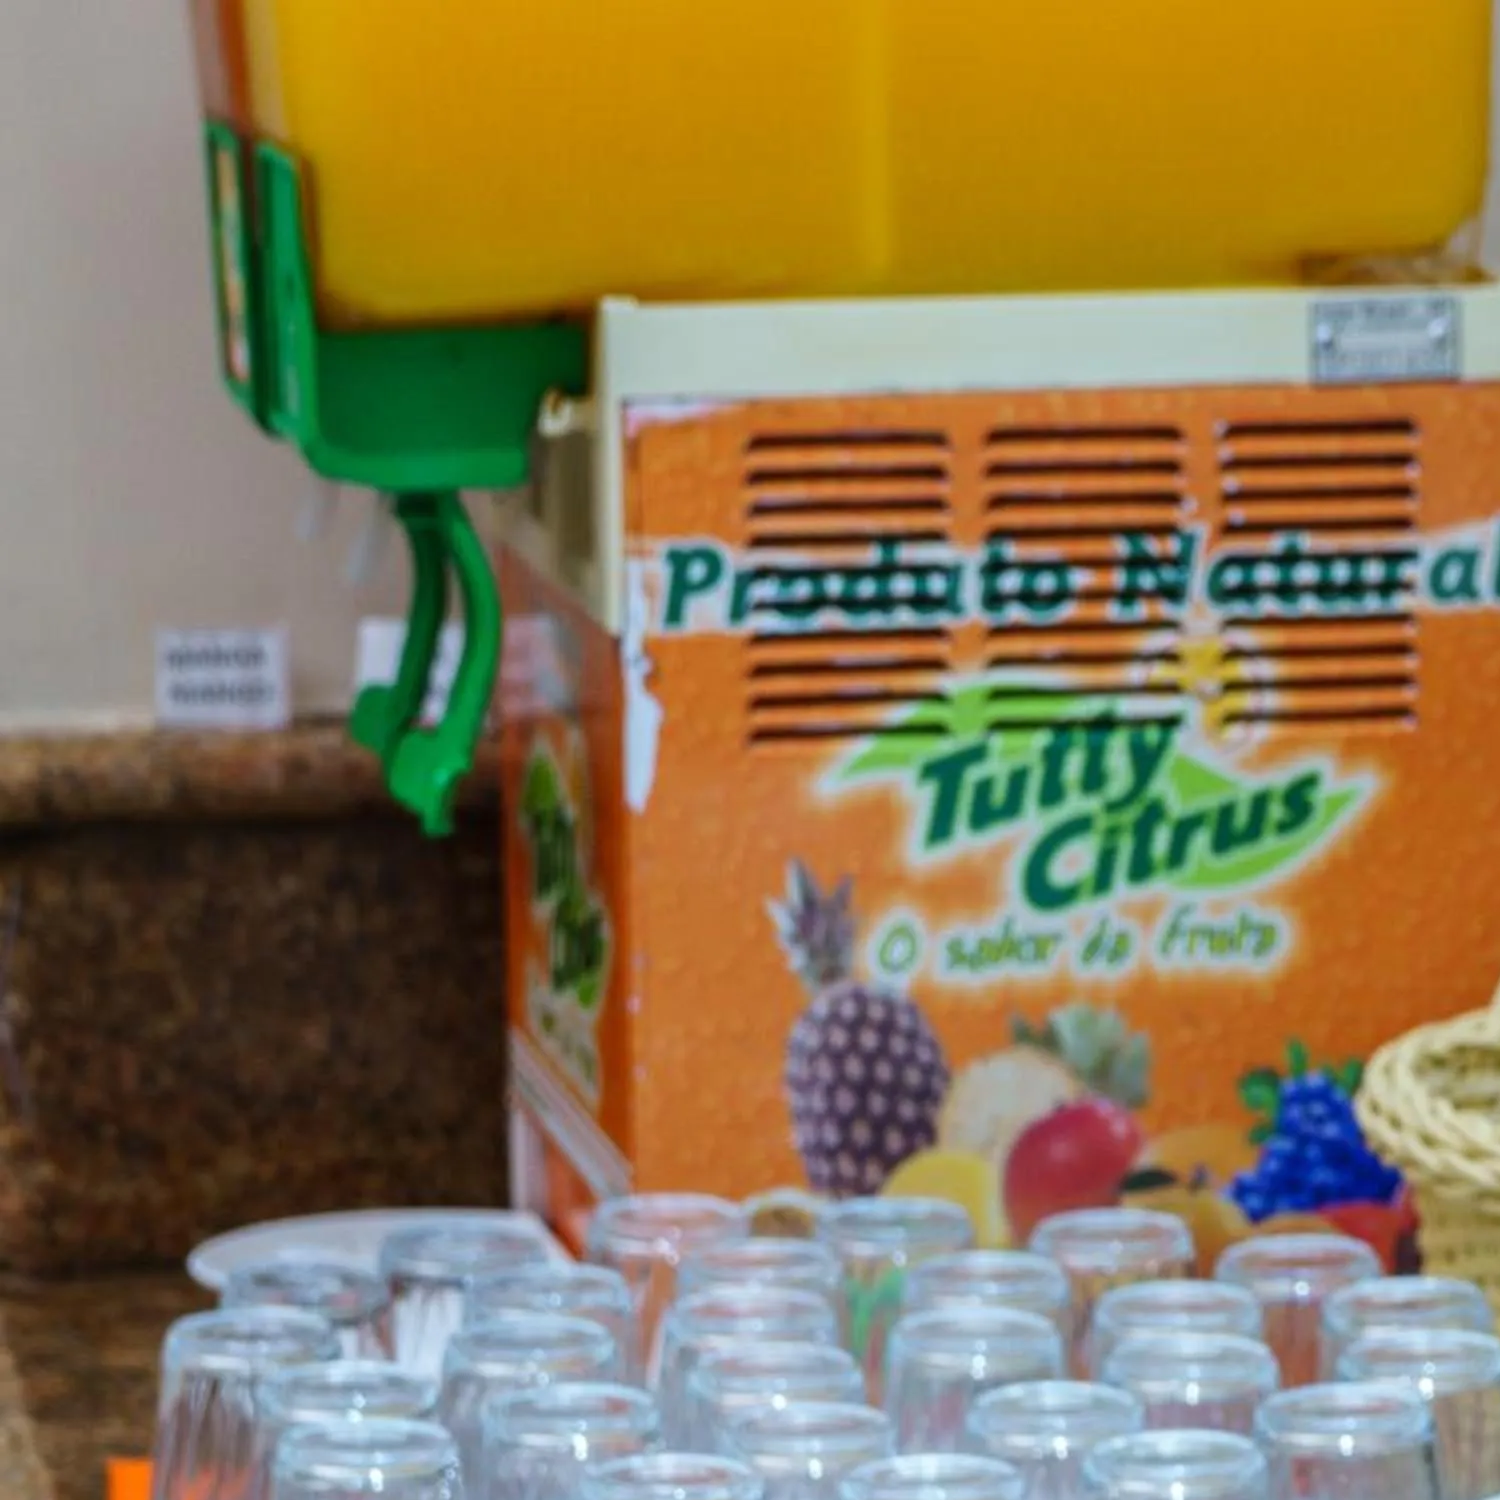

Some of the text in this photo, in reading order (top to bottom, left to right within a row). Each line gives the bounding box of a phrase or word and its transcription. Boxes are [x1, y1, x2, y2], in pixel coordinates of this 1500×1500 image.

[919, 710, 1181, 849] Tutty
[1023, 772, 1320, 911] Citrus
[878, 922, 917, 972] O
